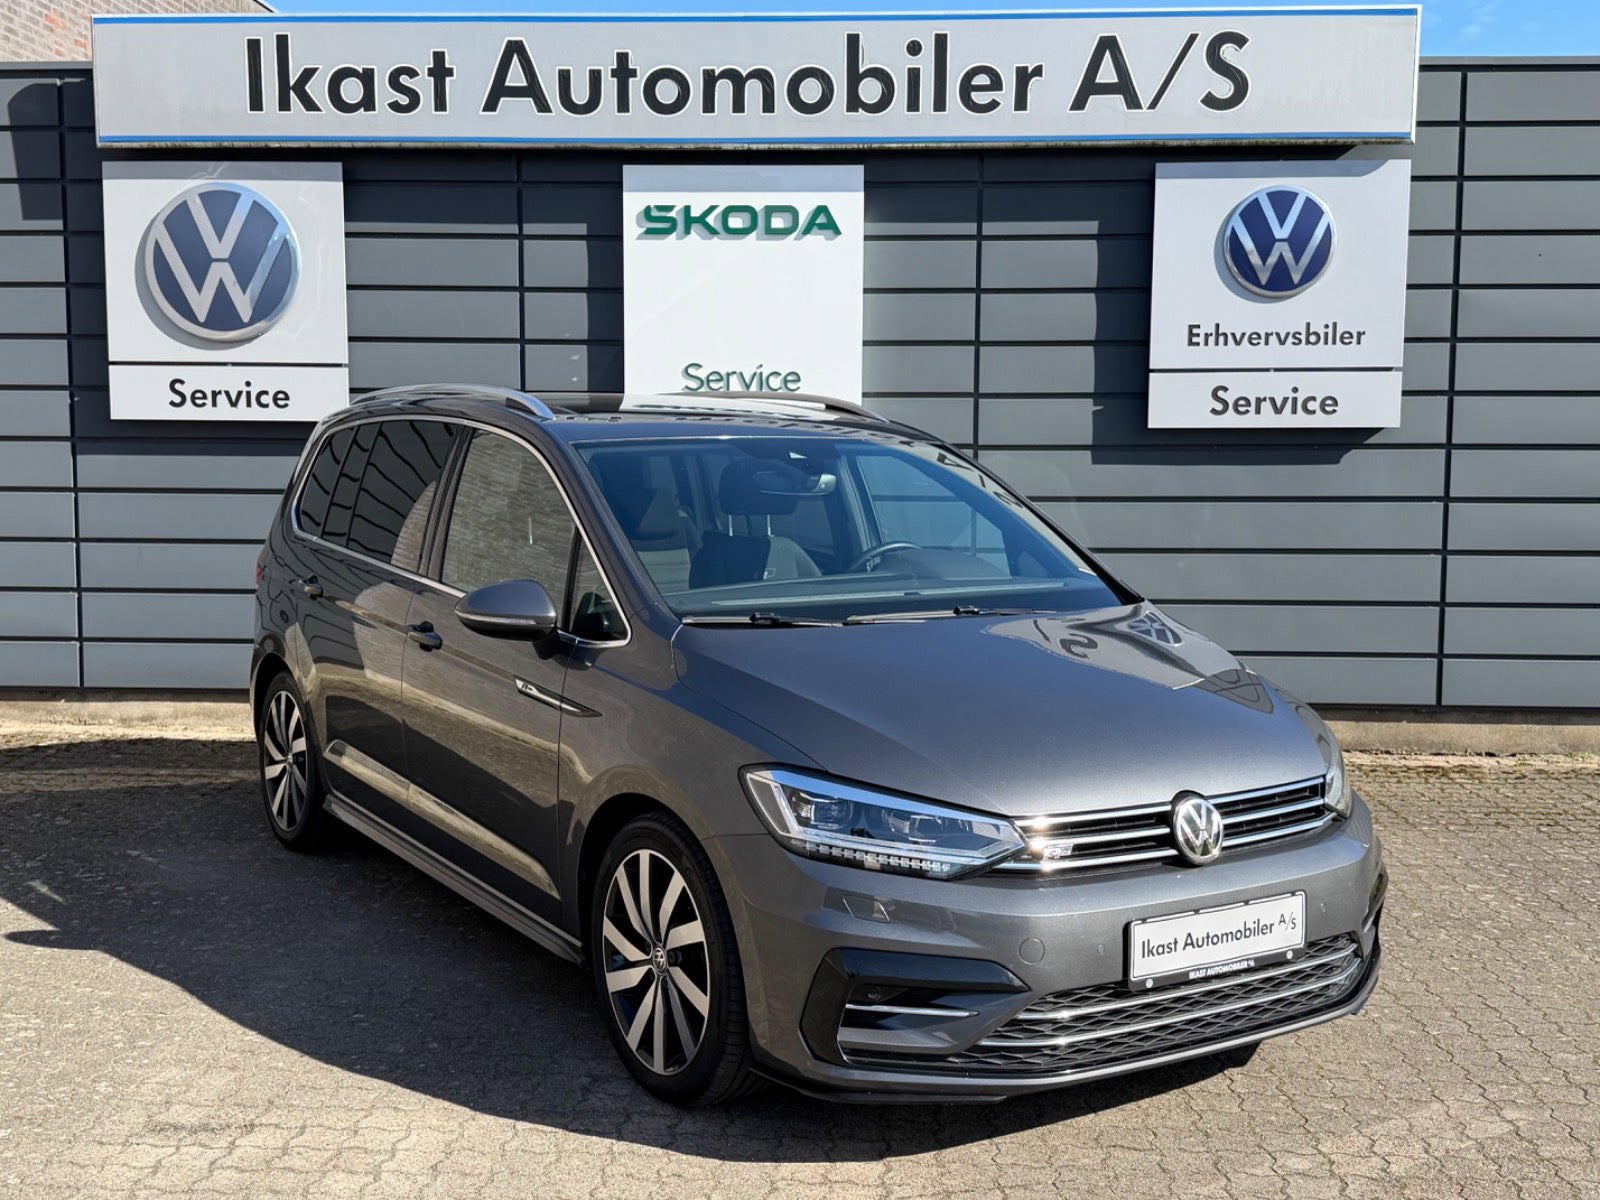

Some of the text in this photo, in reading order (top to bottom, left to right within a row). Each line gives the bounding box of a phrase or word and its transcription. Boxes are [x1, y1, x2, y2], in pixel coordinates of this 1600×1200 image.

[246, 31, 1250, 116] Ikast Automobiler A/S
[1186, 321, 1366, 347] Erhvervsbiler
[683, 362, 802, 392] Service
[168, 378, 291, 409] Service
[1209, 385, 1339, 416] Service
[1141, 911, 1297, 959] Ikast Automobiler A/S
[1189, 968, 1207, 979] IKAST
